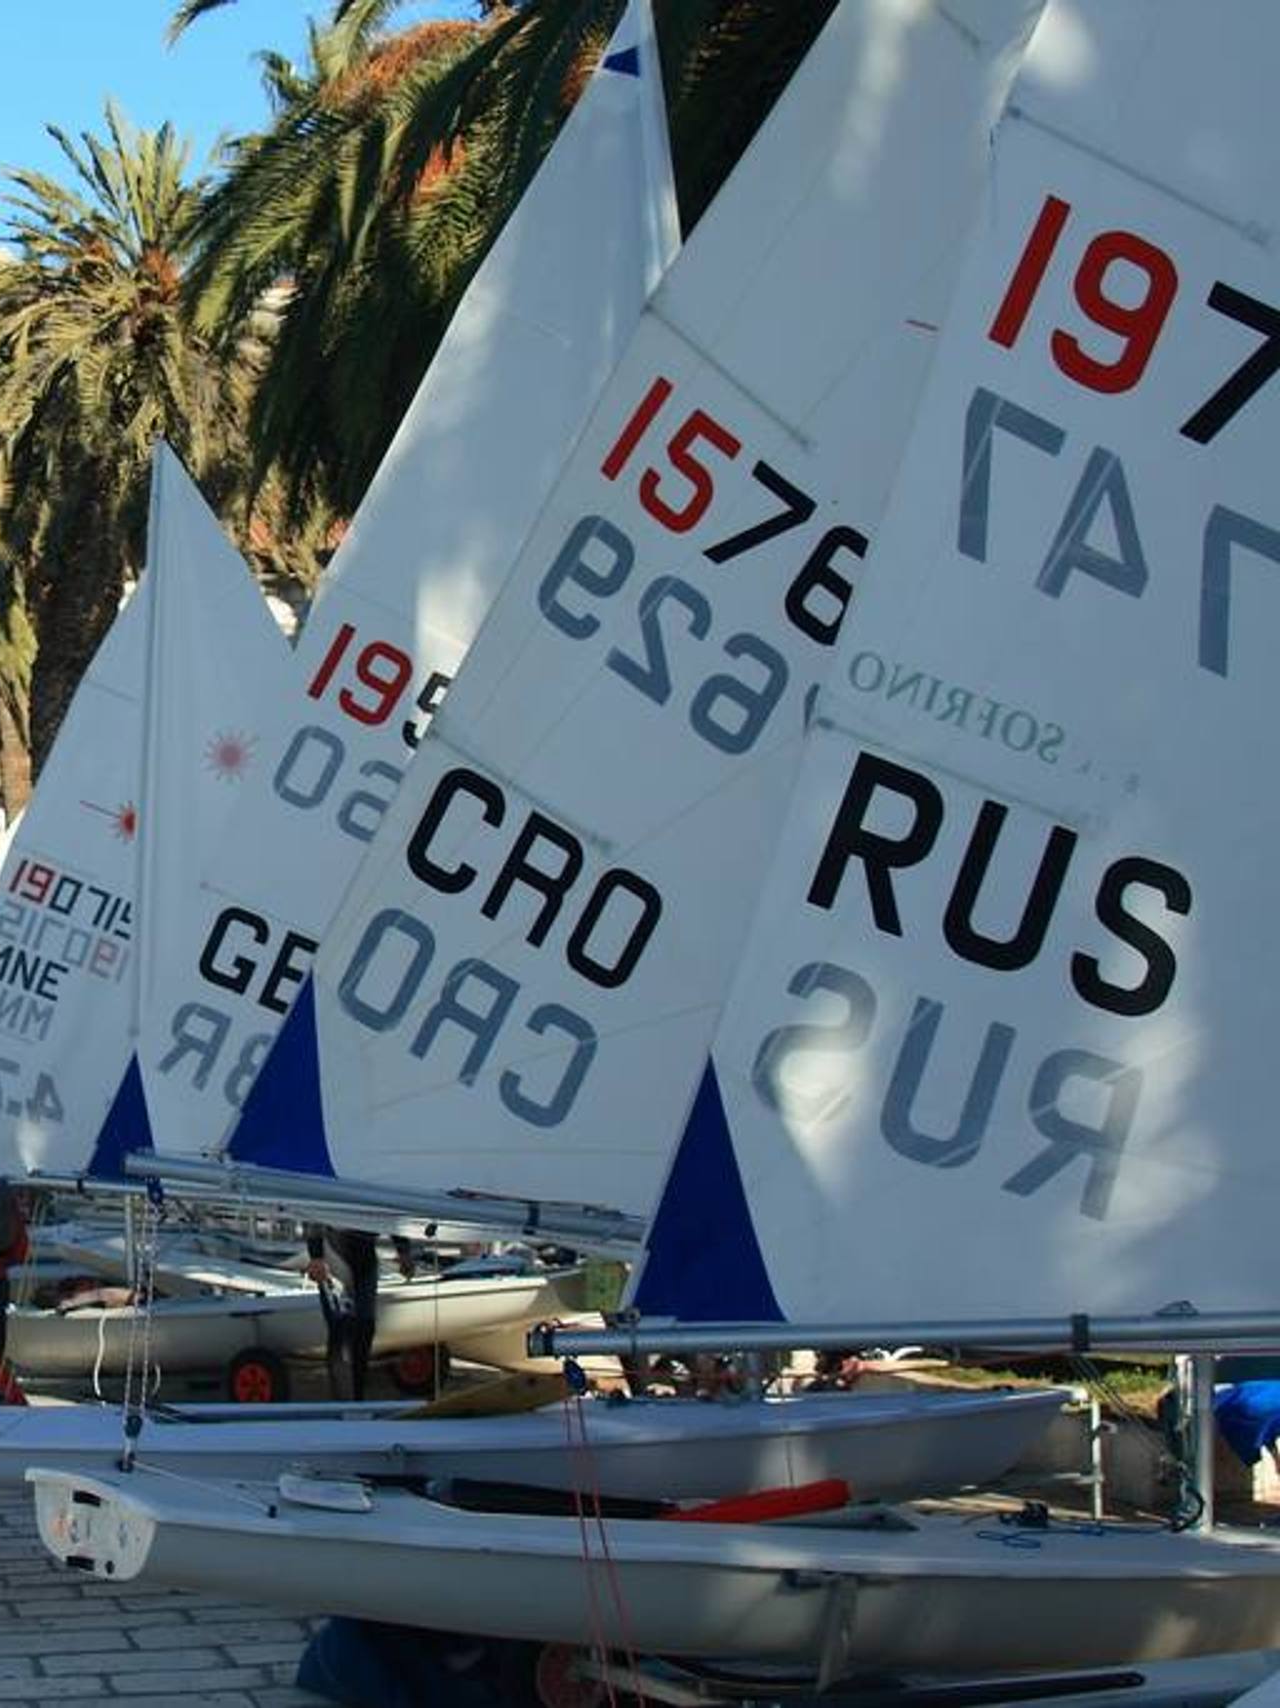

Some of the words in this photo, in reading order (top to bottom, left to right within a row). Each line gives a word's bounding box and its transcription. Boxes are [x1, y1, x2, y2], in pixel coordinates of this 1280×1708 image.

[987, 194, 1280, 445] 197
[601, 376, 869, 647] 1576
[407, 768, 662, 989] CRO
[807, 750, 1192, 1017] RUS
